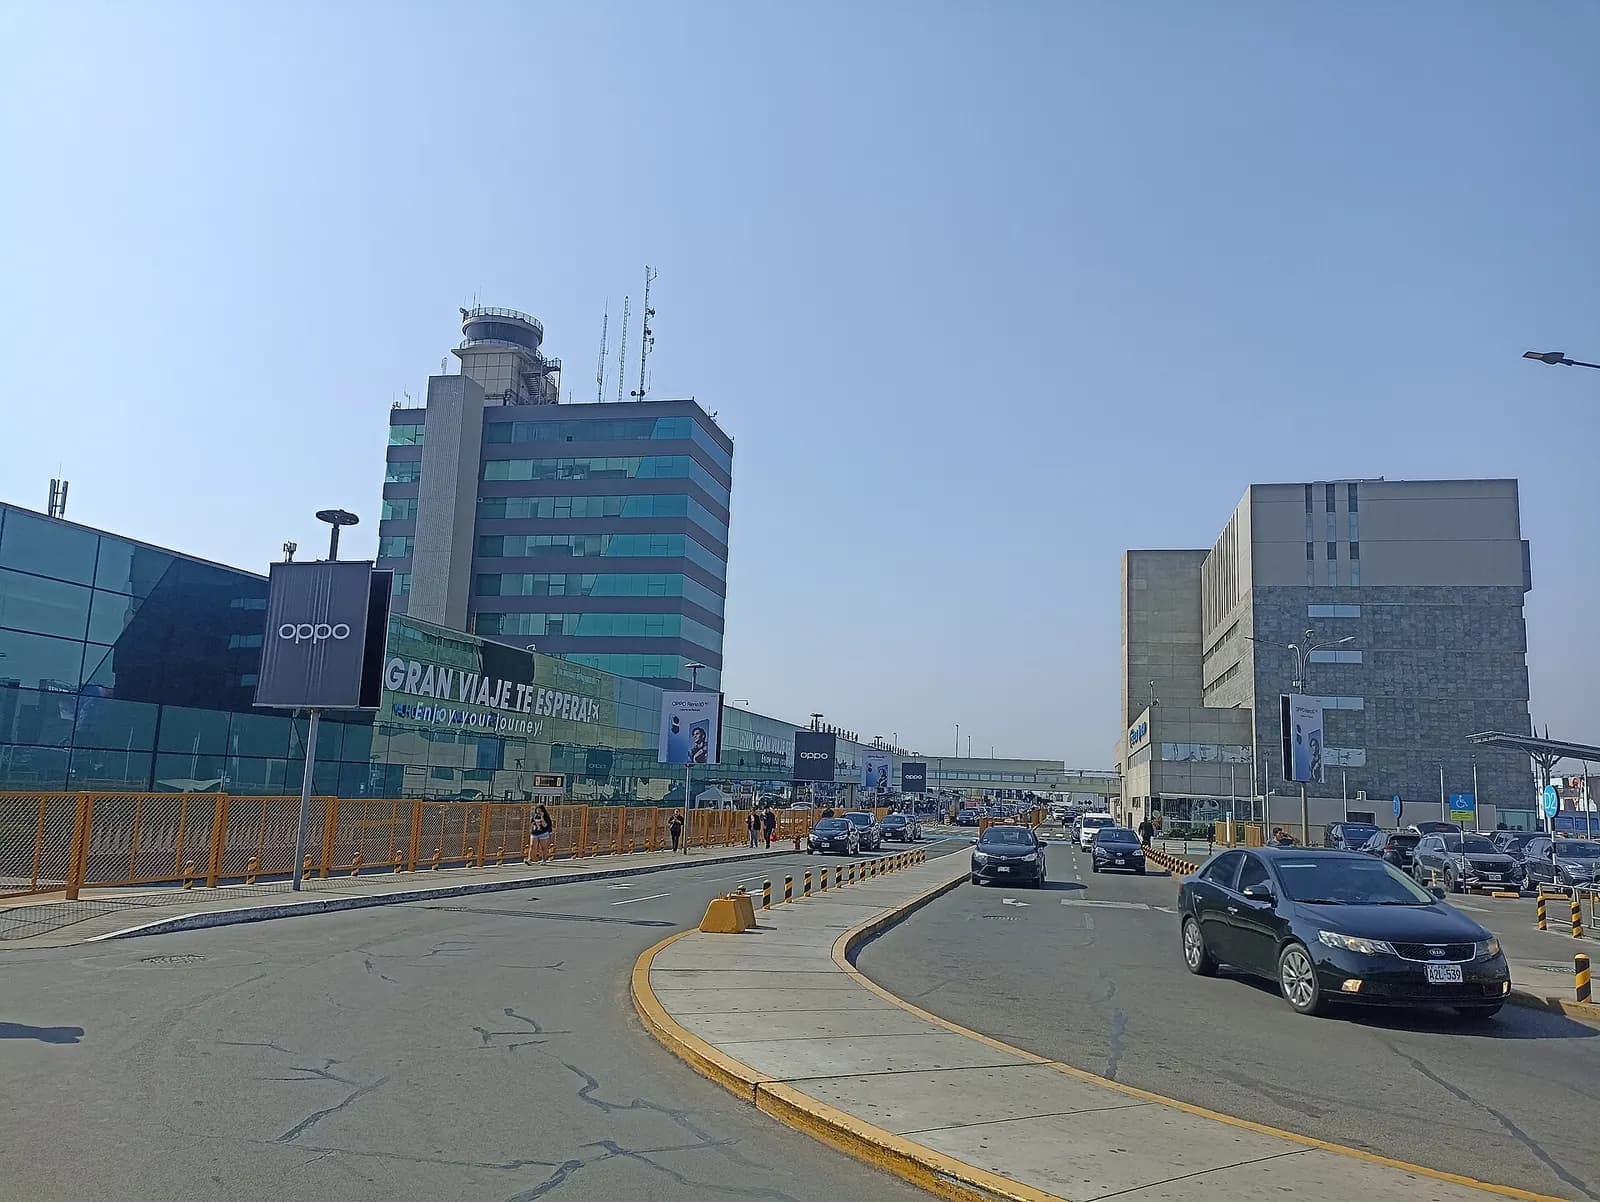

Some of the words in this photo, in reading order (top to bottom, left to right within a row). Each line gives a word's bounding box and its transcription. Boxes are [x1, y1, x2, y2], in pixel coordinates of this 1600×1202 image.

[279, 623, 350, 644] oppo
[385, 658, 453, 700] GRAN
[460, 671, 512, 710] VIAJE
[516, 683, 534, 713] TE
[535, 688, 592, 723] ESPERA!
[415, 701, 456, 727] Enjoy
[461, 710, 491, 729] your
[495, 712, 543, 737] journey!
[800, 752, 828, 760] oppo
[1544, 792, 1556, 809] D2
[1429, 969, 1461, 981] A2L-539
